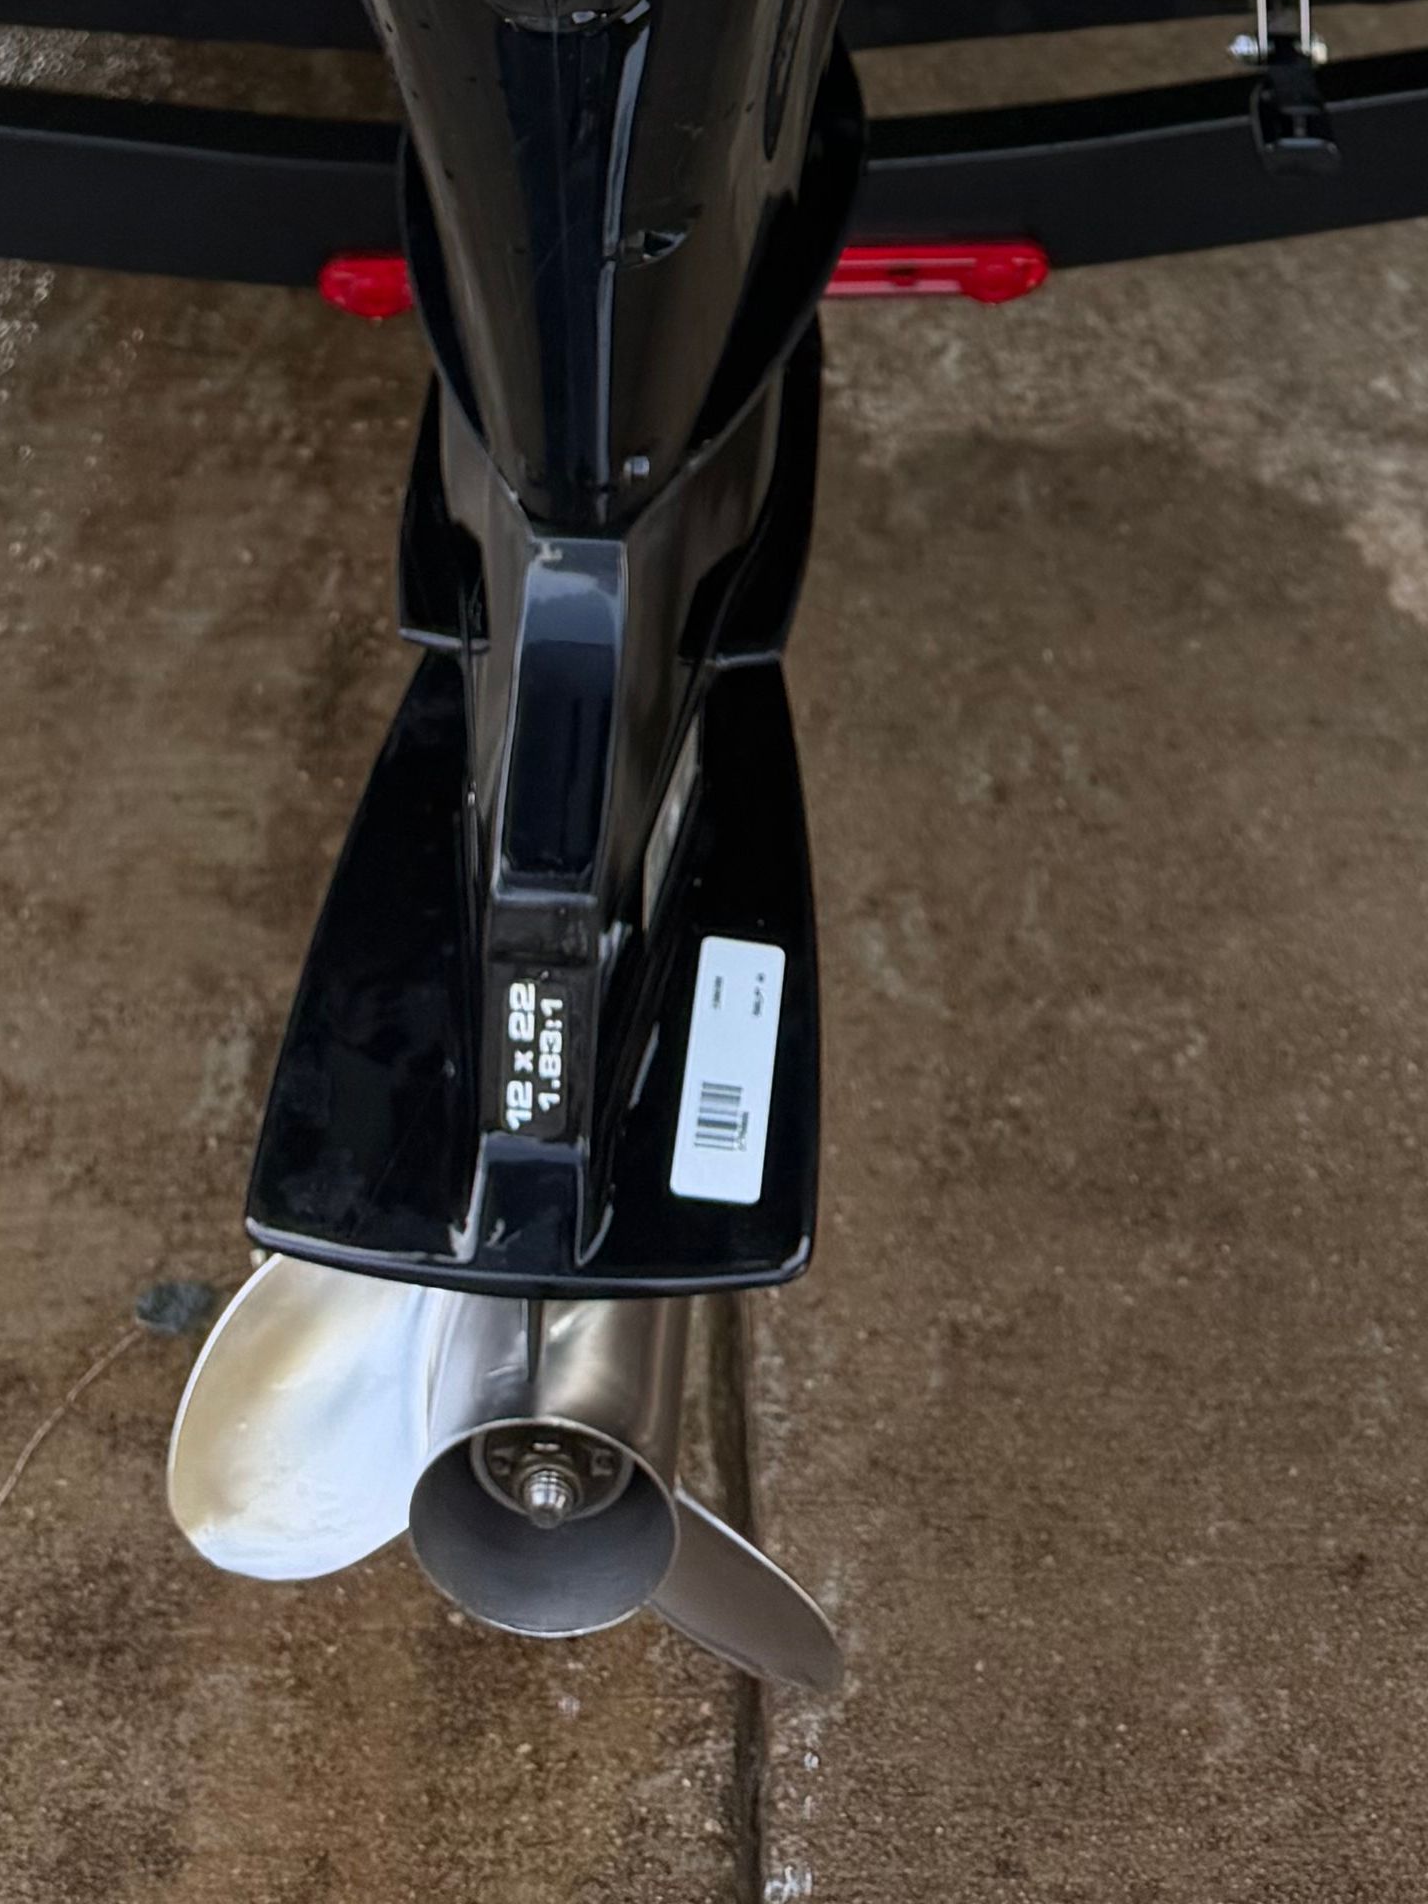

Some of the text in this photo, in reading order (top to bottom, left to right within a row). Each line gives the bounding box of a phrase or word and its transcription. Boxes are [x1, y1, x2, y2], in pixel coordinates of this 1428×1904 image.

[508, 981, 536, 1042] 22
[538, 997, 564, 1113] 1.83:1
[506, 1079, 534, 1132] 12
